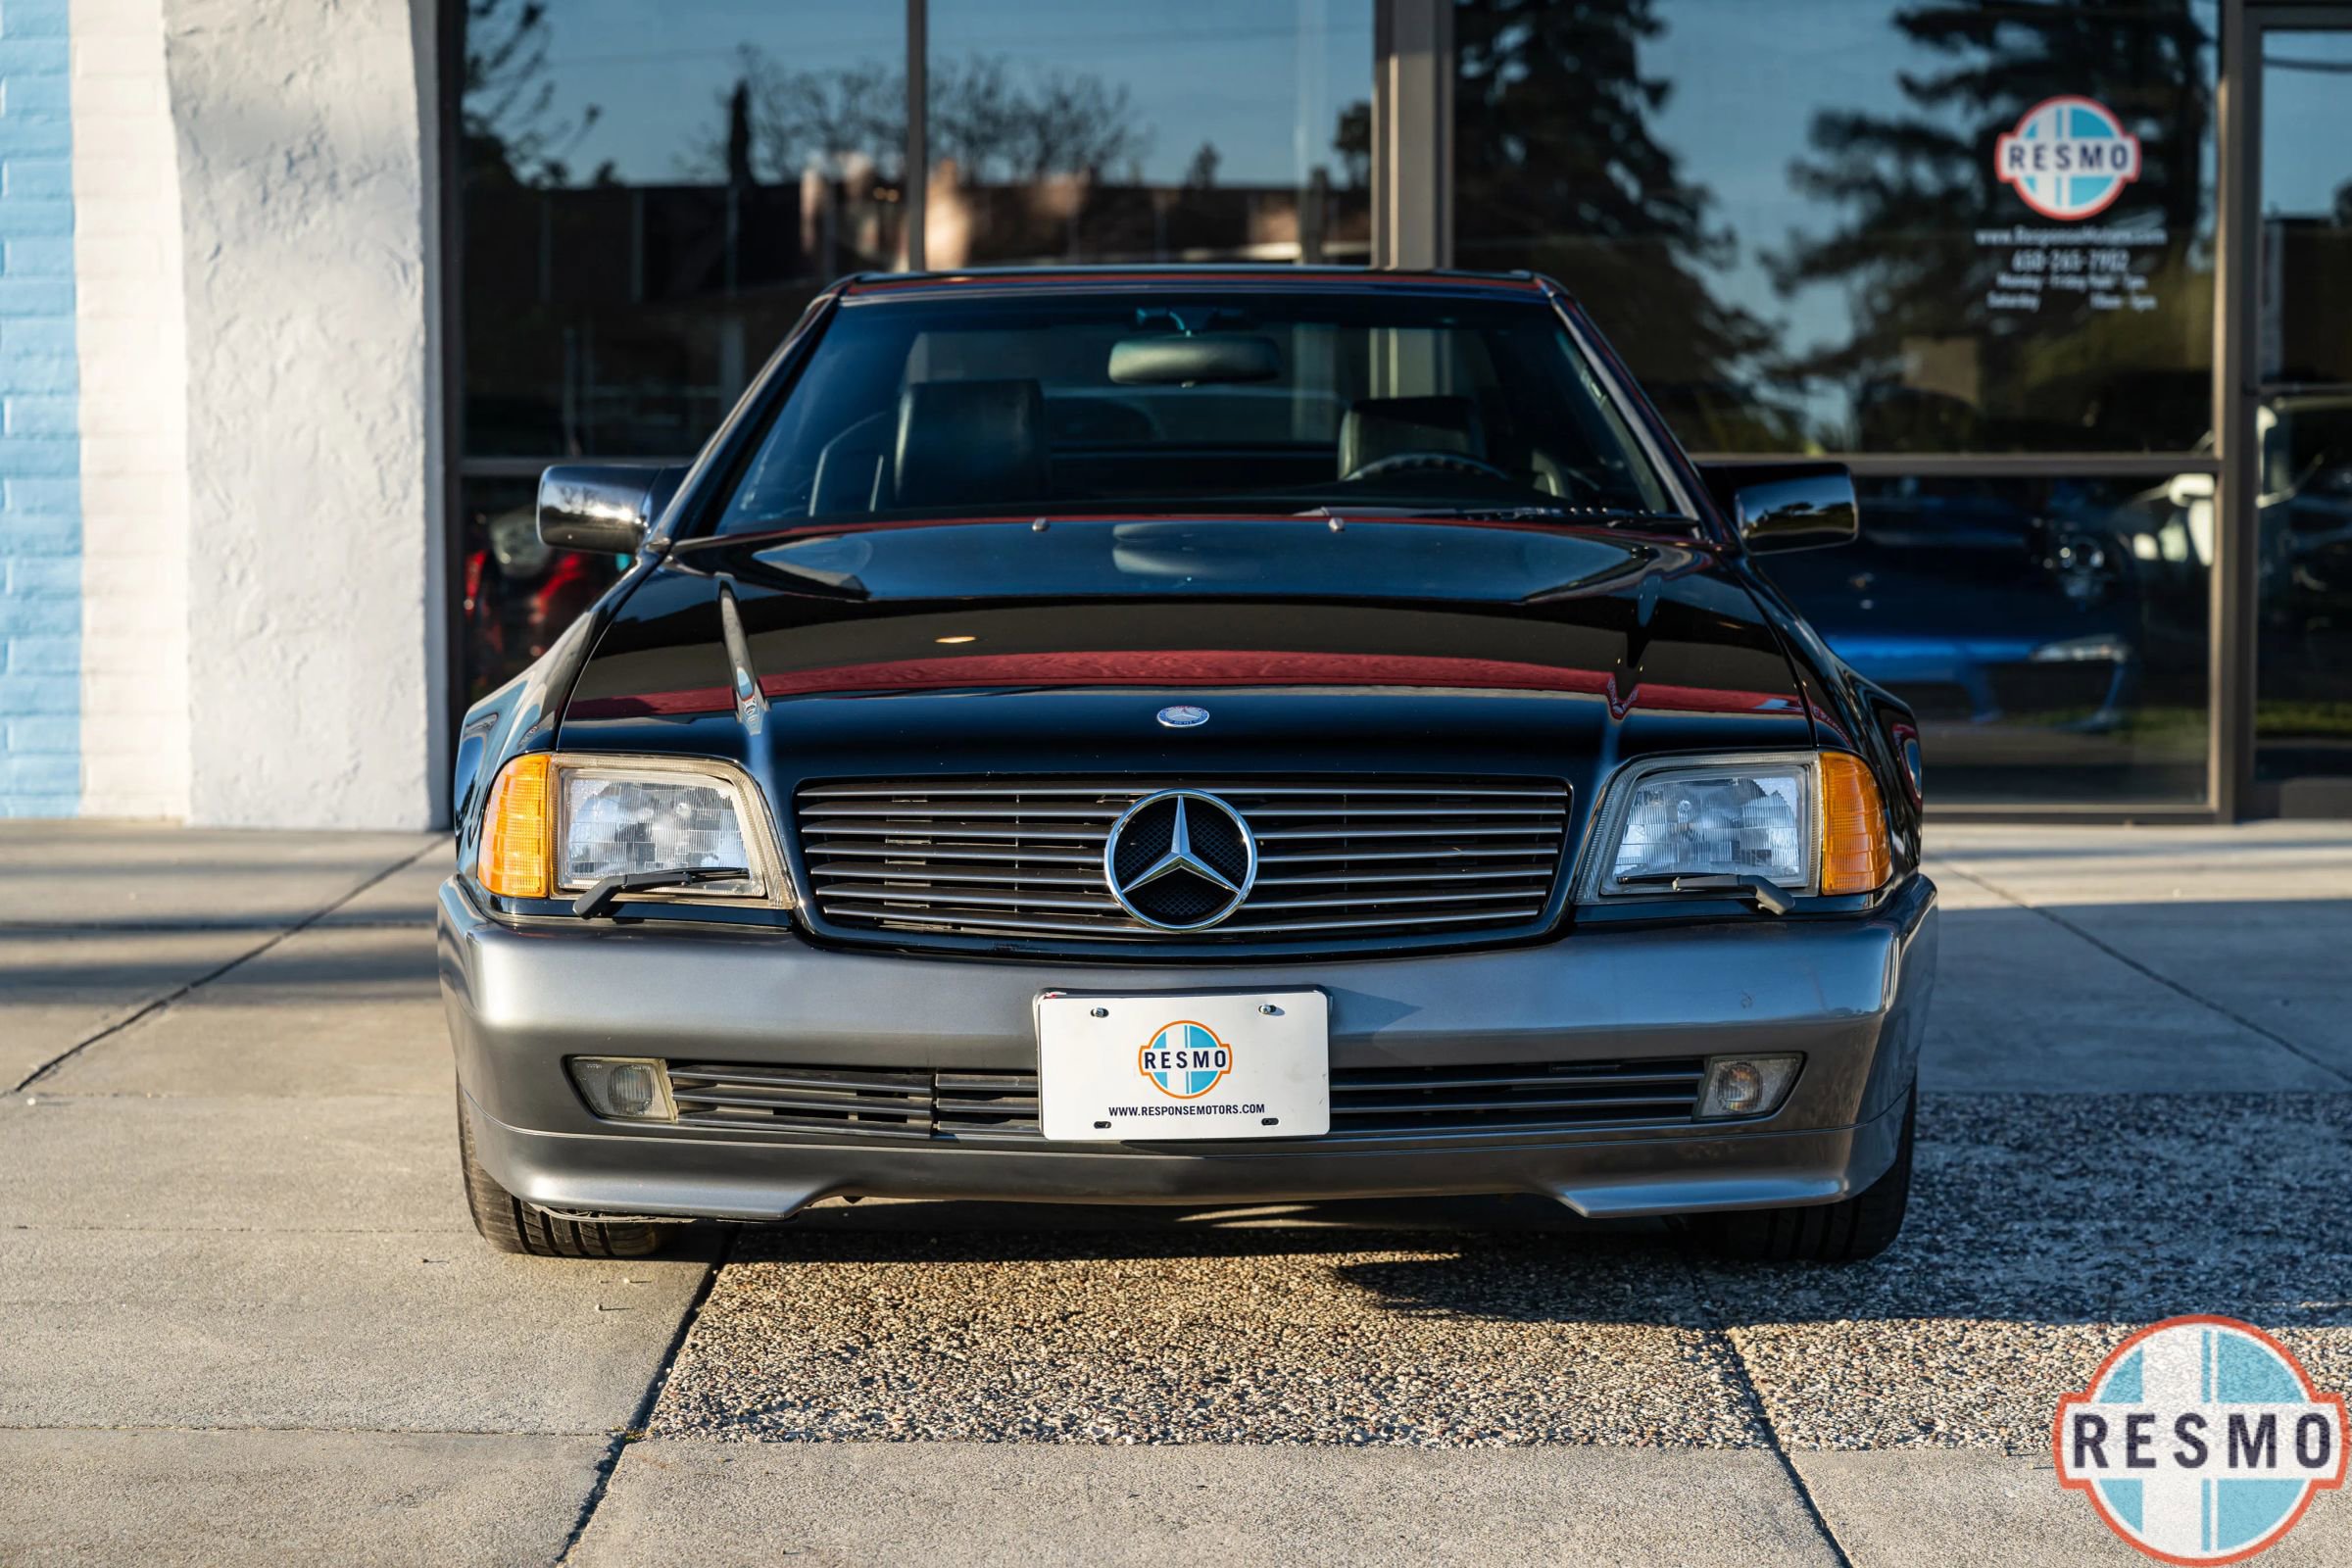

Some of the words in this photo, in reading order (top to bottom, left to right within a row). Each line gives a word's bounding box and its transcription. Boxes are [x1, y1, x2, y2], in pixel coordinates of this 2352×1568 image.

[2009, 145, 2129, 170] RESMO
[1144, 1050, 1226, 1069] RESMO
[1108, 1103, 1265, 1116] WWW.RESPONSEMOTORS.COM
